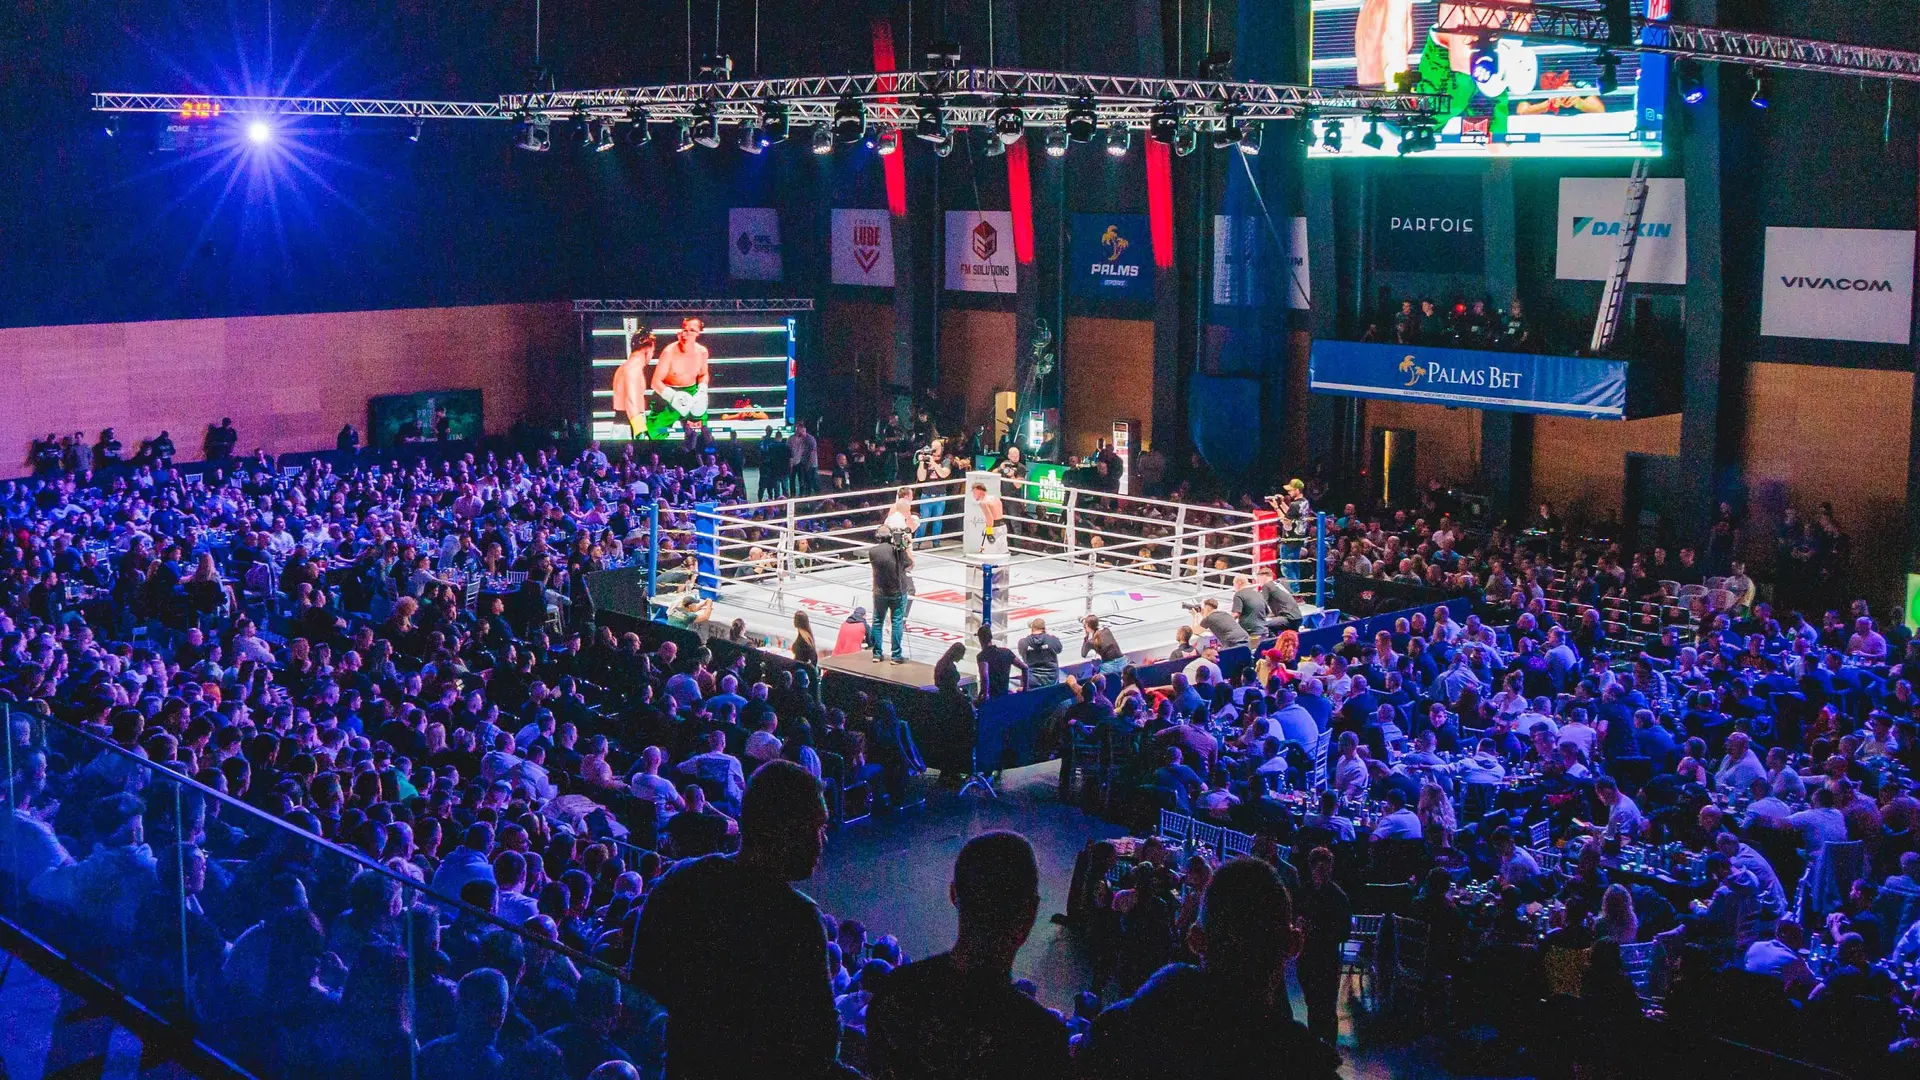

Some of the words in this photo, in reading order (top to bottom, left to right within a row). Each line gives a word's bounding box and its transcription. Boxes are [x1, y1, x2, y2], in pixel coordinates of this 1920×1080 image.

[1390, 217, 1474, 232] PARFOIS
[973, 264, 1010, 277] SOLUTIONS
[1091, 263, 1139, 277] PALMS
[1780, 276, 1893, 293] VIVACOM
